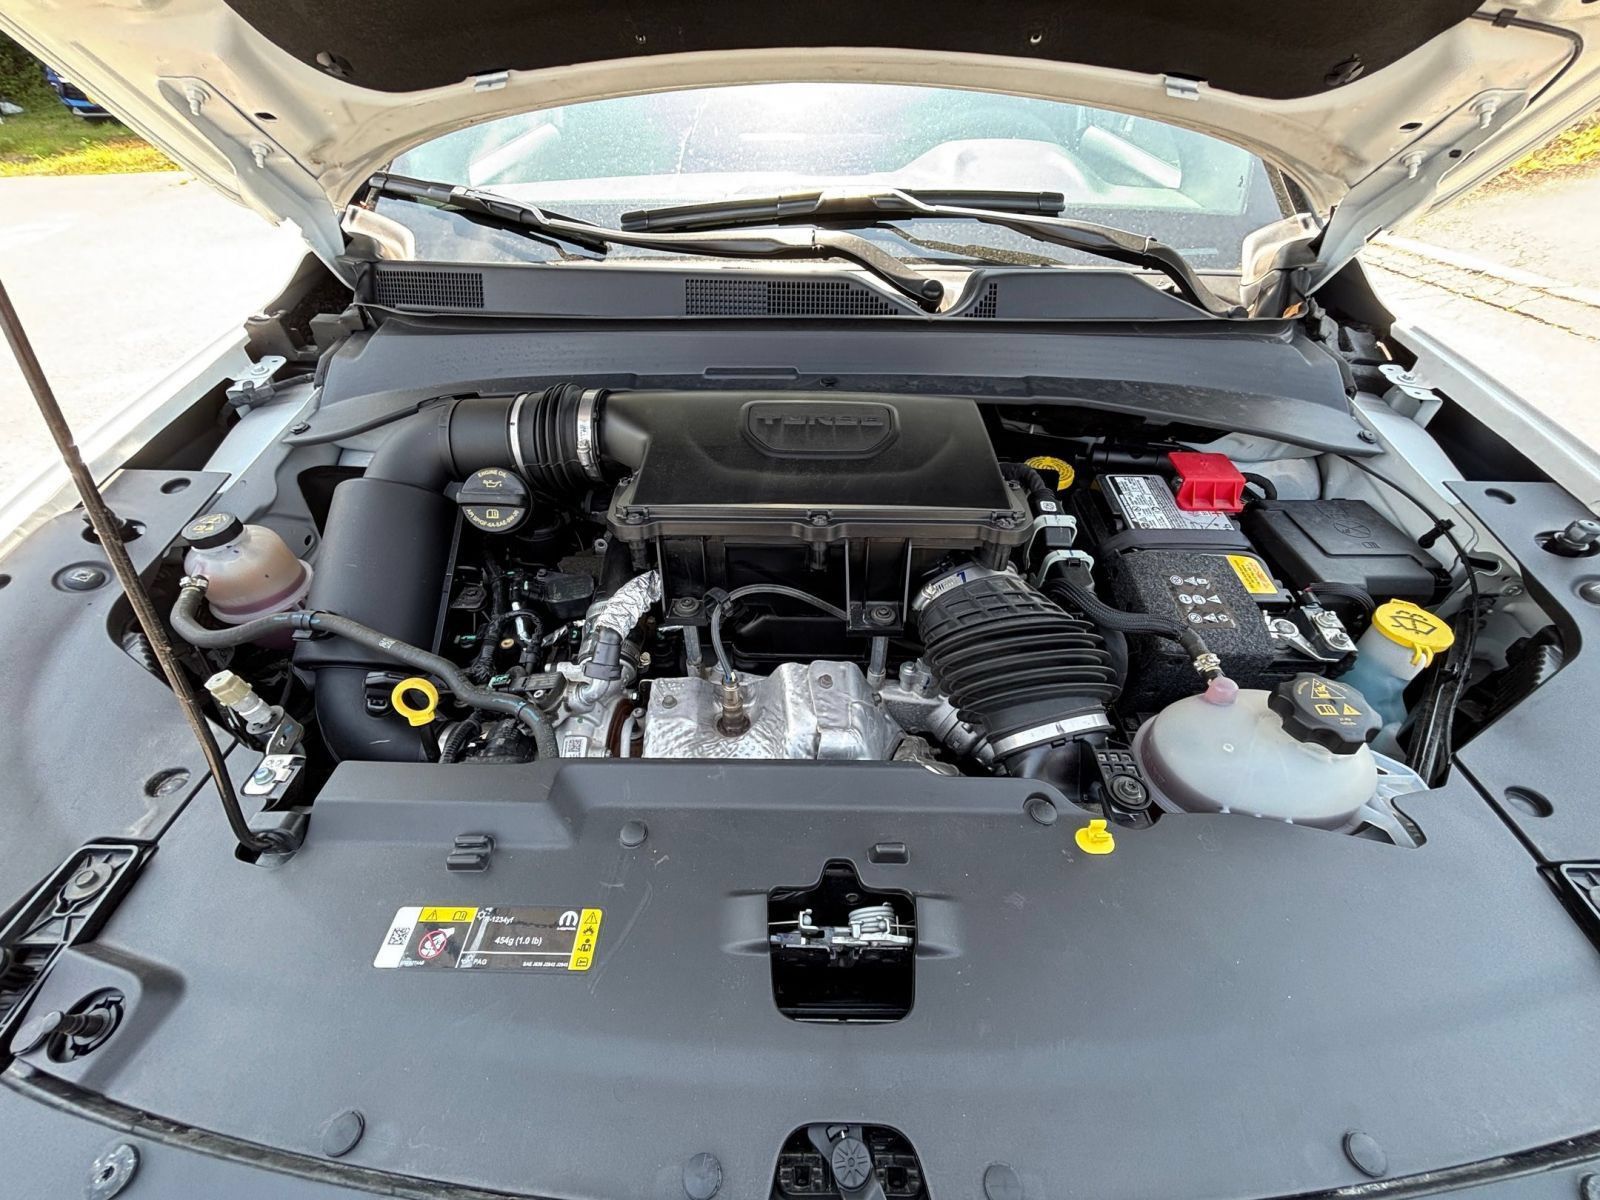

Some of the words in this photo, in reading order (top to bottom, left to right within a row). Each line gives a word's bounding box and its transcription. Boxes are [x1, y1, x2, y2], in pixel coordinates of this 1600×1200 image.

[477, 469, 498, 478] ENGINE
[498, 470, 507, 479] OIL
[494, 936, 515, 946] 454g
[515, 936, 530, 946] (1.0
[530, 936, 543, 946] lb)
[473, 958, 488, 966] PAG
